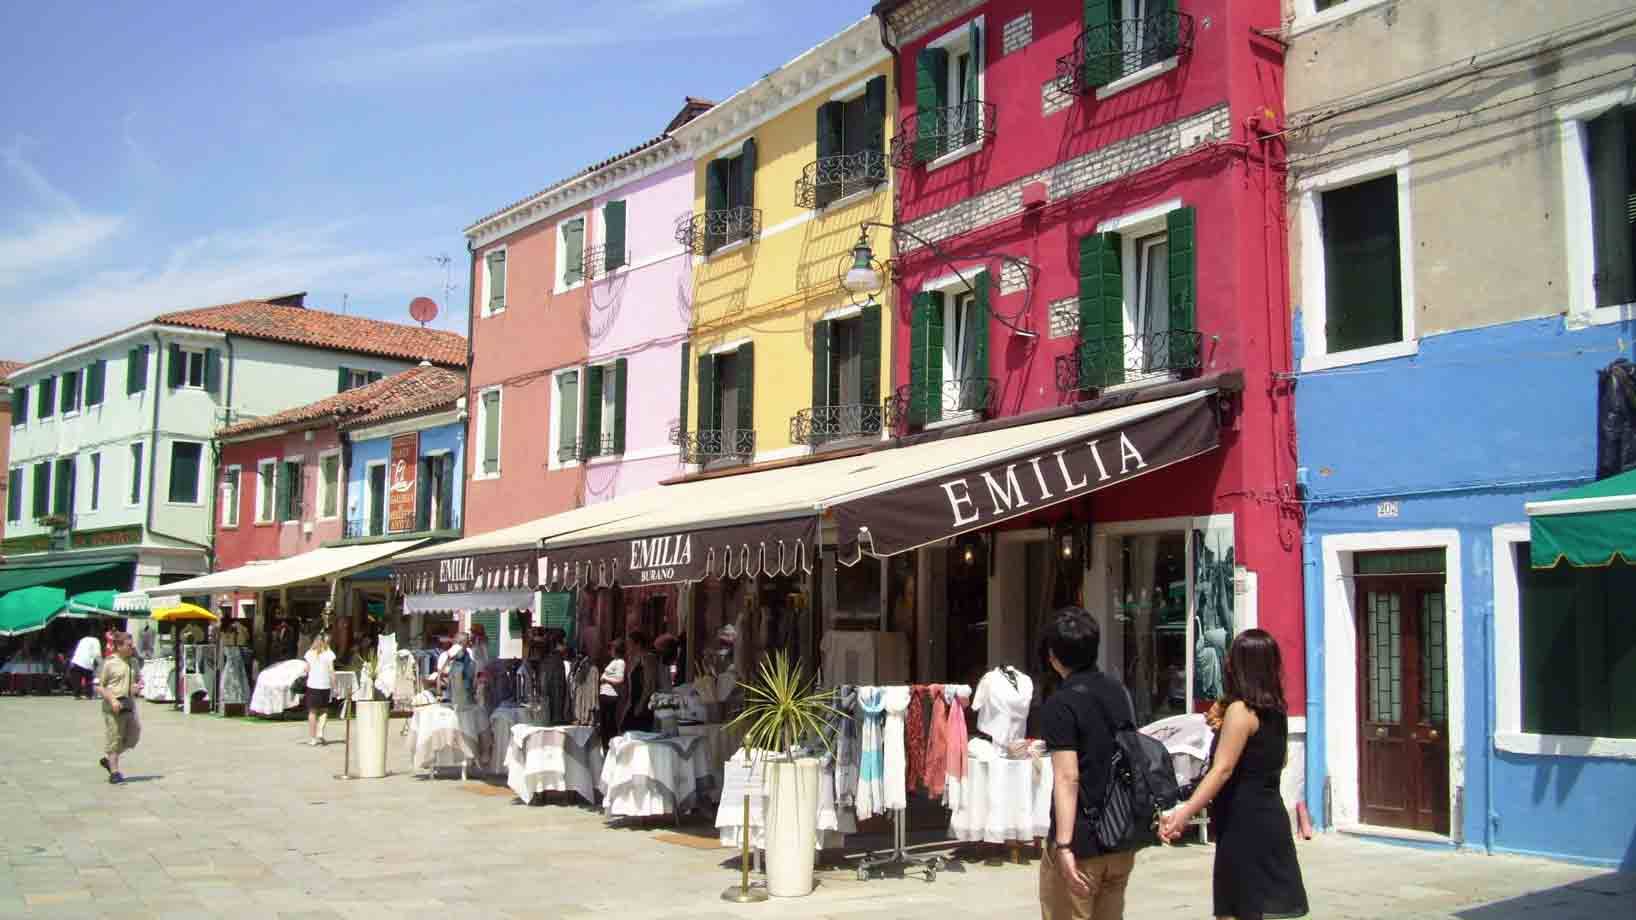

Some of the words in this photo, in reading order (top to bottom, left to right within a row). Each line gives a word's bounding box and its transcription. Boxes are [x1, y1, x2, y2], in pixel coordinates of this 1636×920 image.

[940, 431, 1148, 528] EMILIA
[629, 534, 691, 570] EMILIA
[440, 557, 474, 583] EMILIA
[641, 568, 674, 582] BURANO
